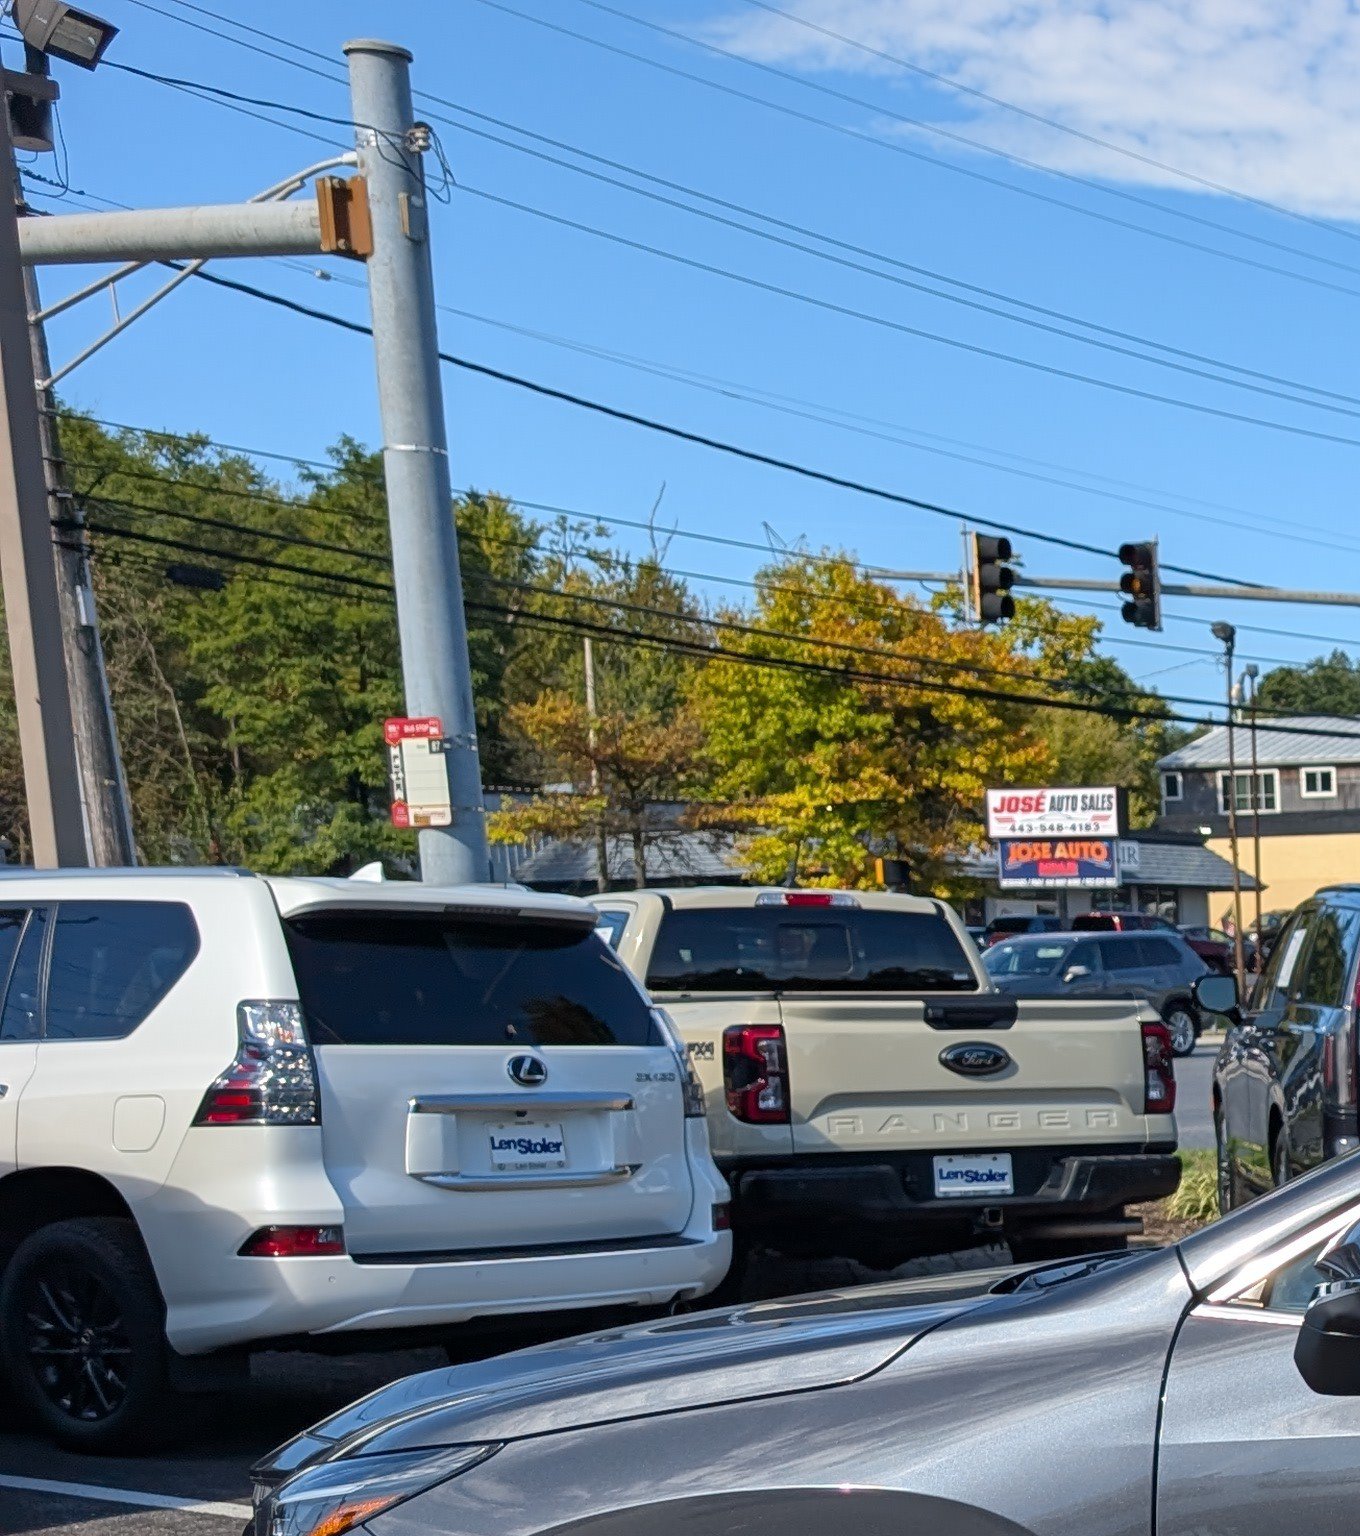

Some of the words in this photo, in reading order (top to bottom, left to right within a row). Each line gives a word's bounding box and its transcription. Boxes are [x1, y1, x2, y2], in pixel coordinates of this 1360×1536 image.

[993, 789, 1046, 813] JOSÉ
[1049, 795, 1078, 812] AUTO
[1080, 793, 1114, 811] SALES
[1008, 841, 1052, 865] JOSE
[1054, 841, 1109, 863] AUTO
[827, 1109, 1118, 1136] RANGER
